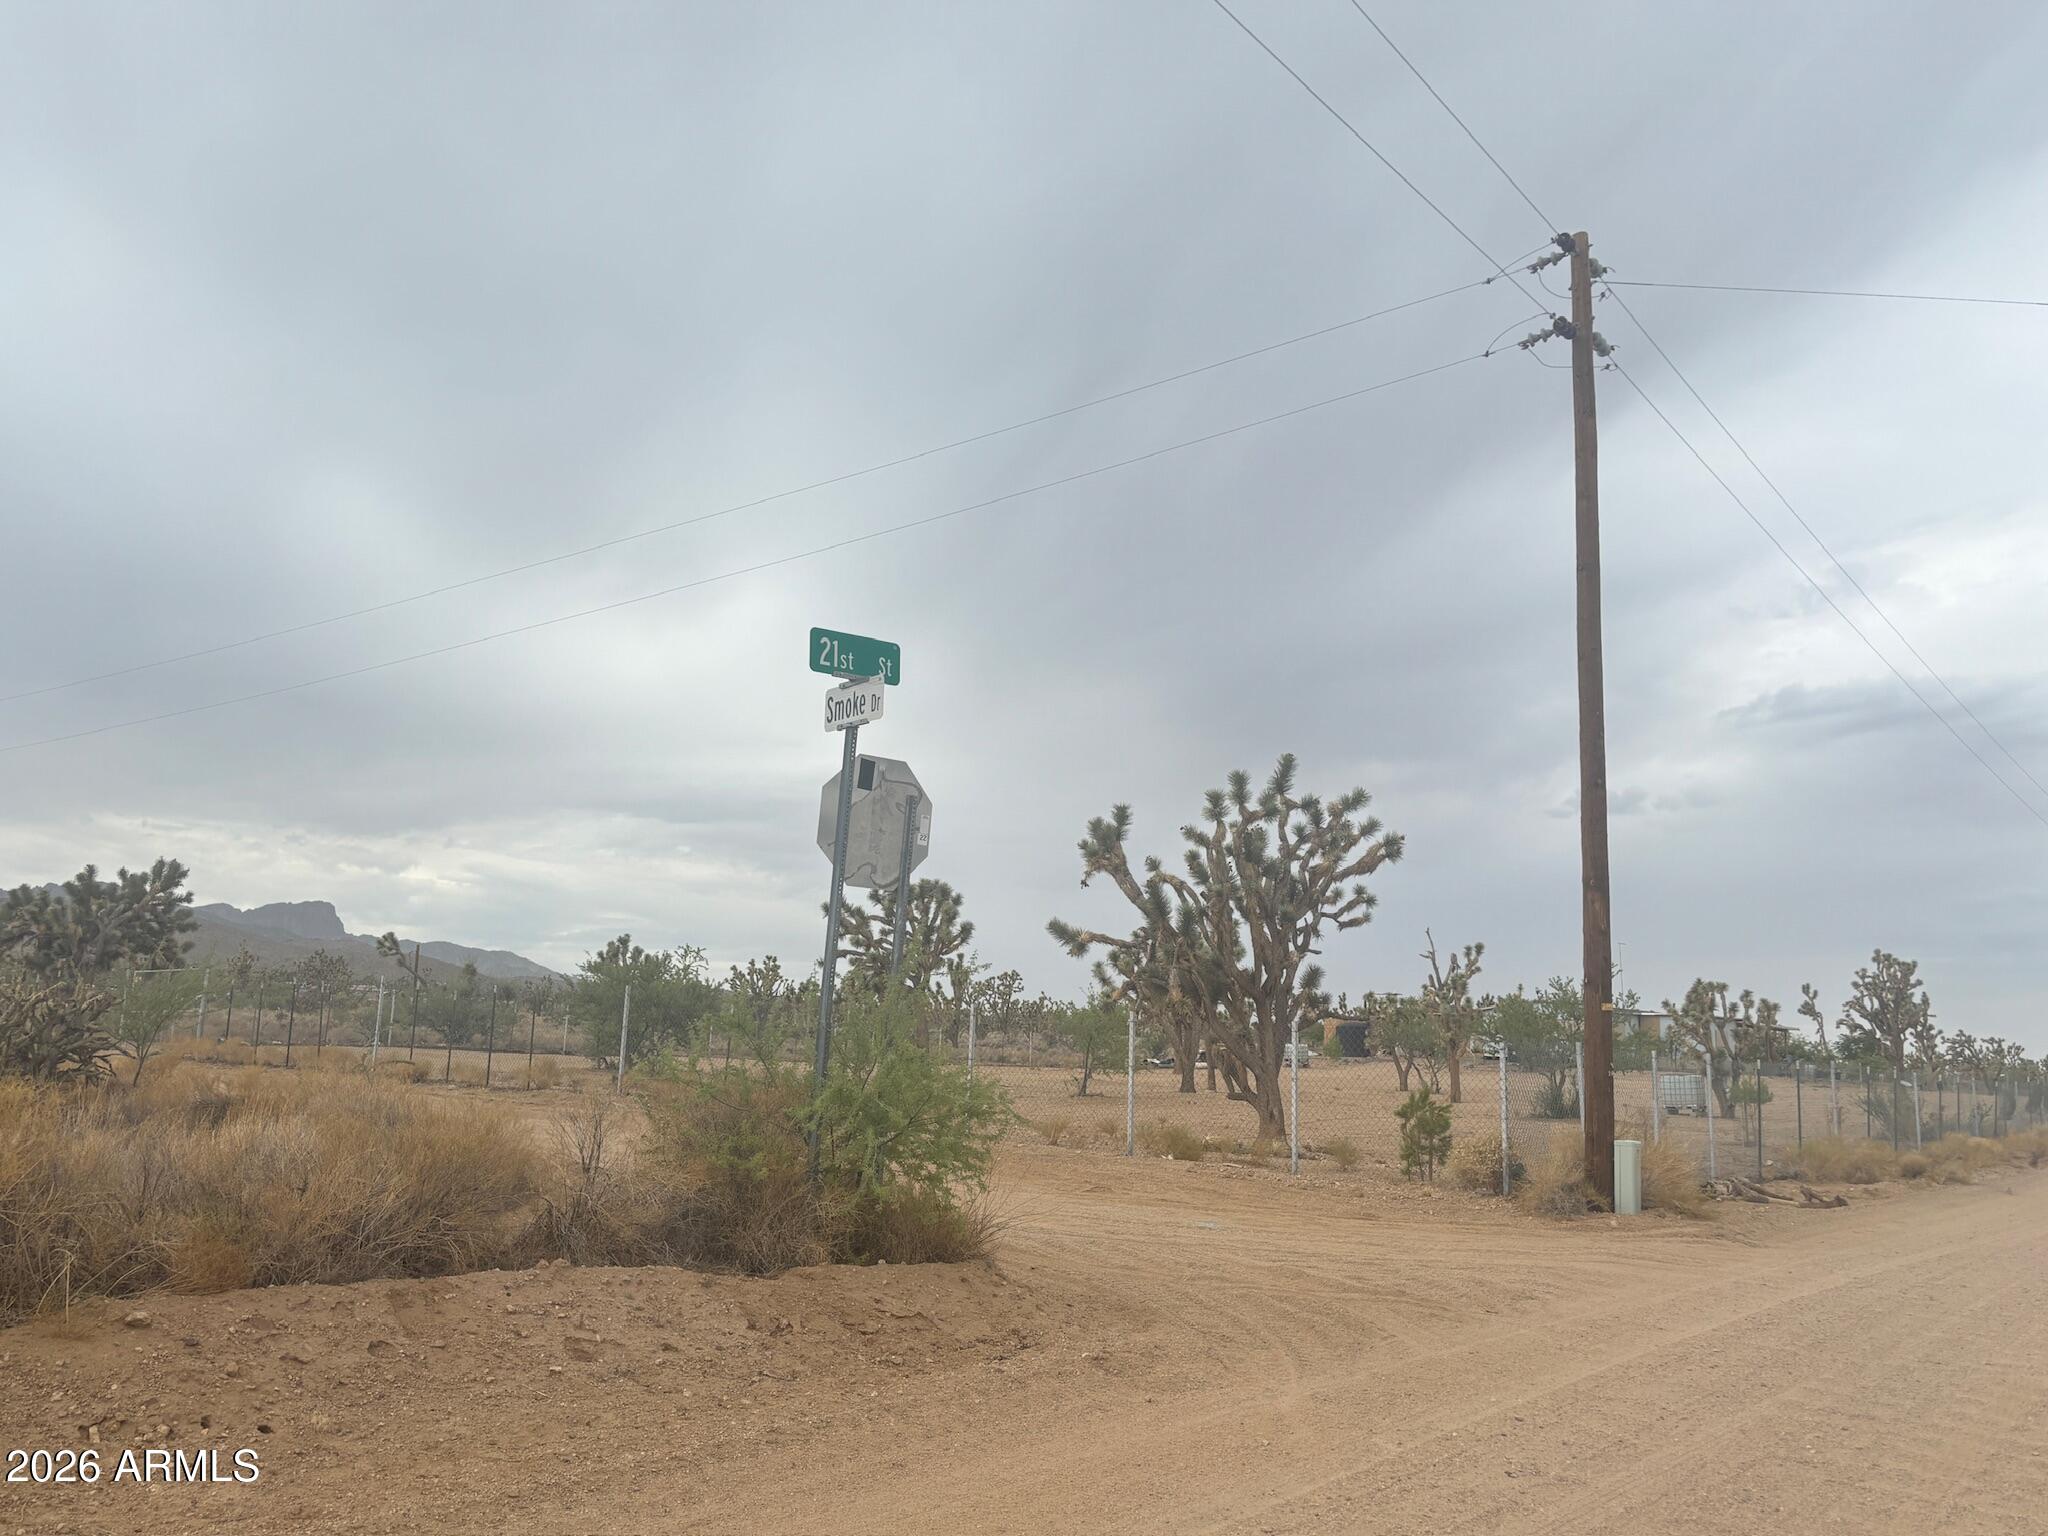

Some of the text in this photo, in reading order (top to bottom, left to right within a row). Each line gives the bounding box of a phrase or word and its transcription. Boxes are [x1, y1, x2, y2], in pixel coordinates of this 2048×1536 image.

[819, 636, 893, 677] 21st St
[826, 691, 881, 723] Smoke Dr
